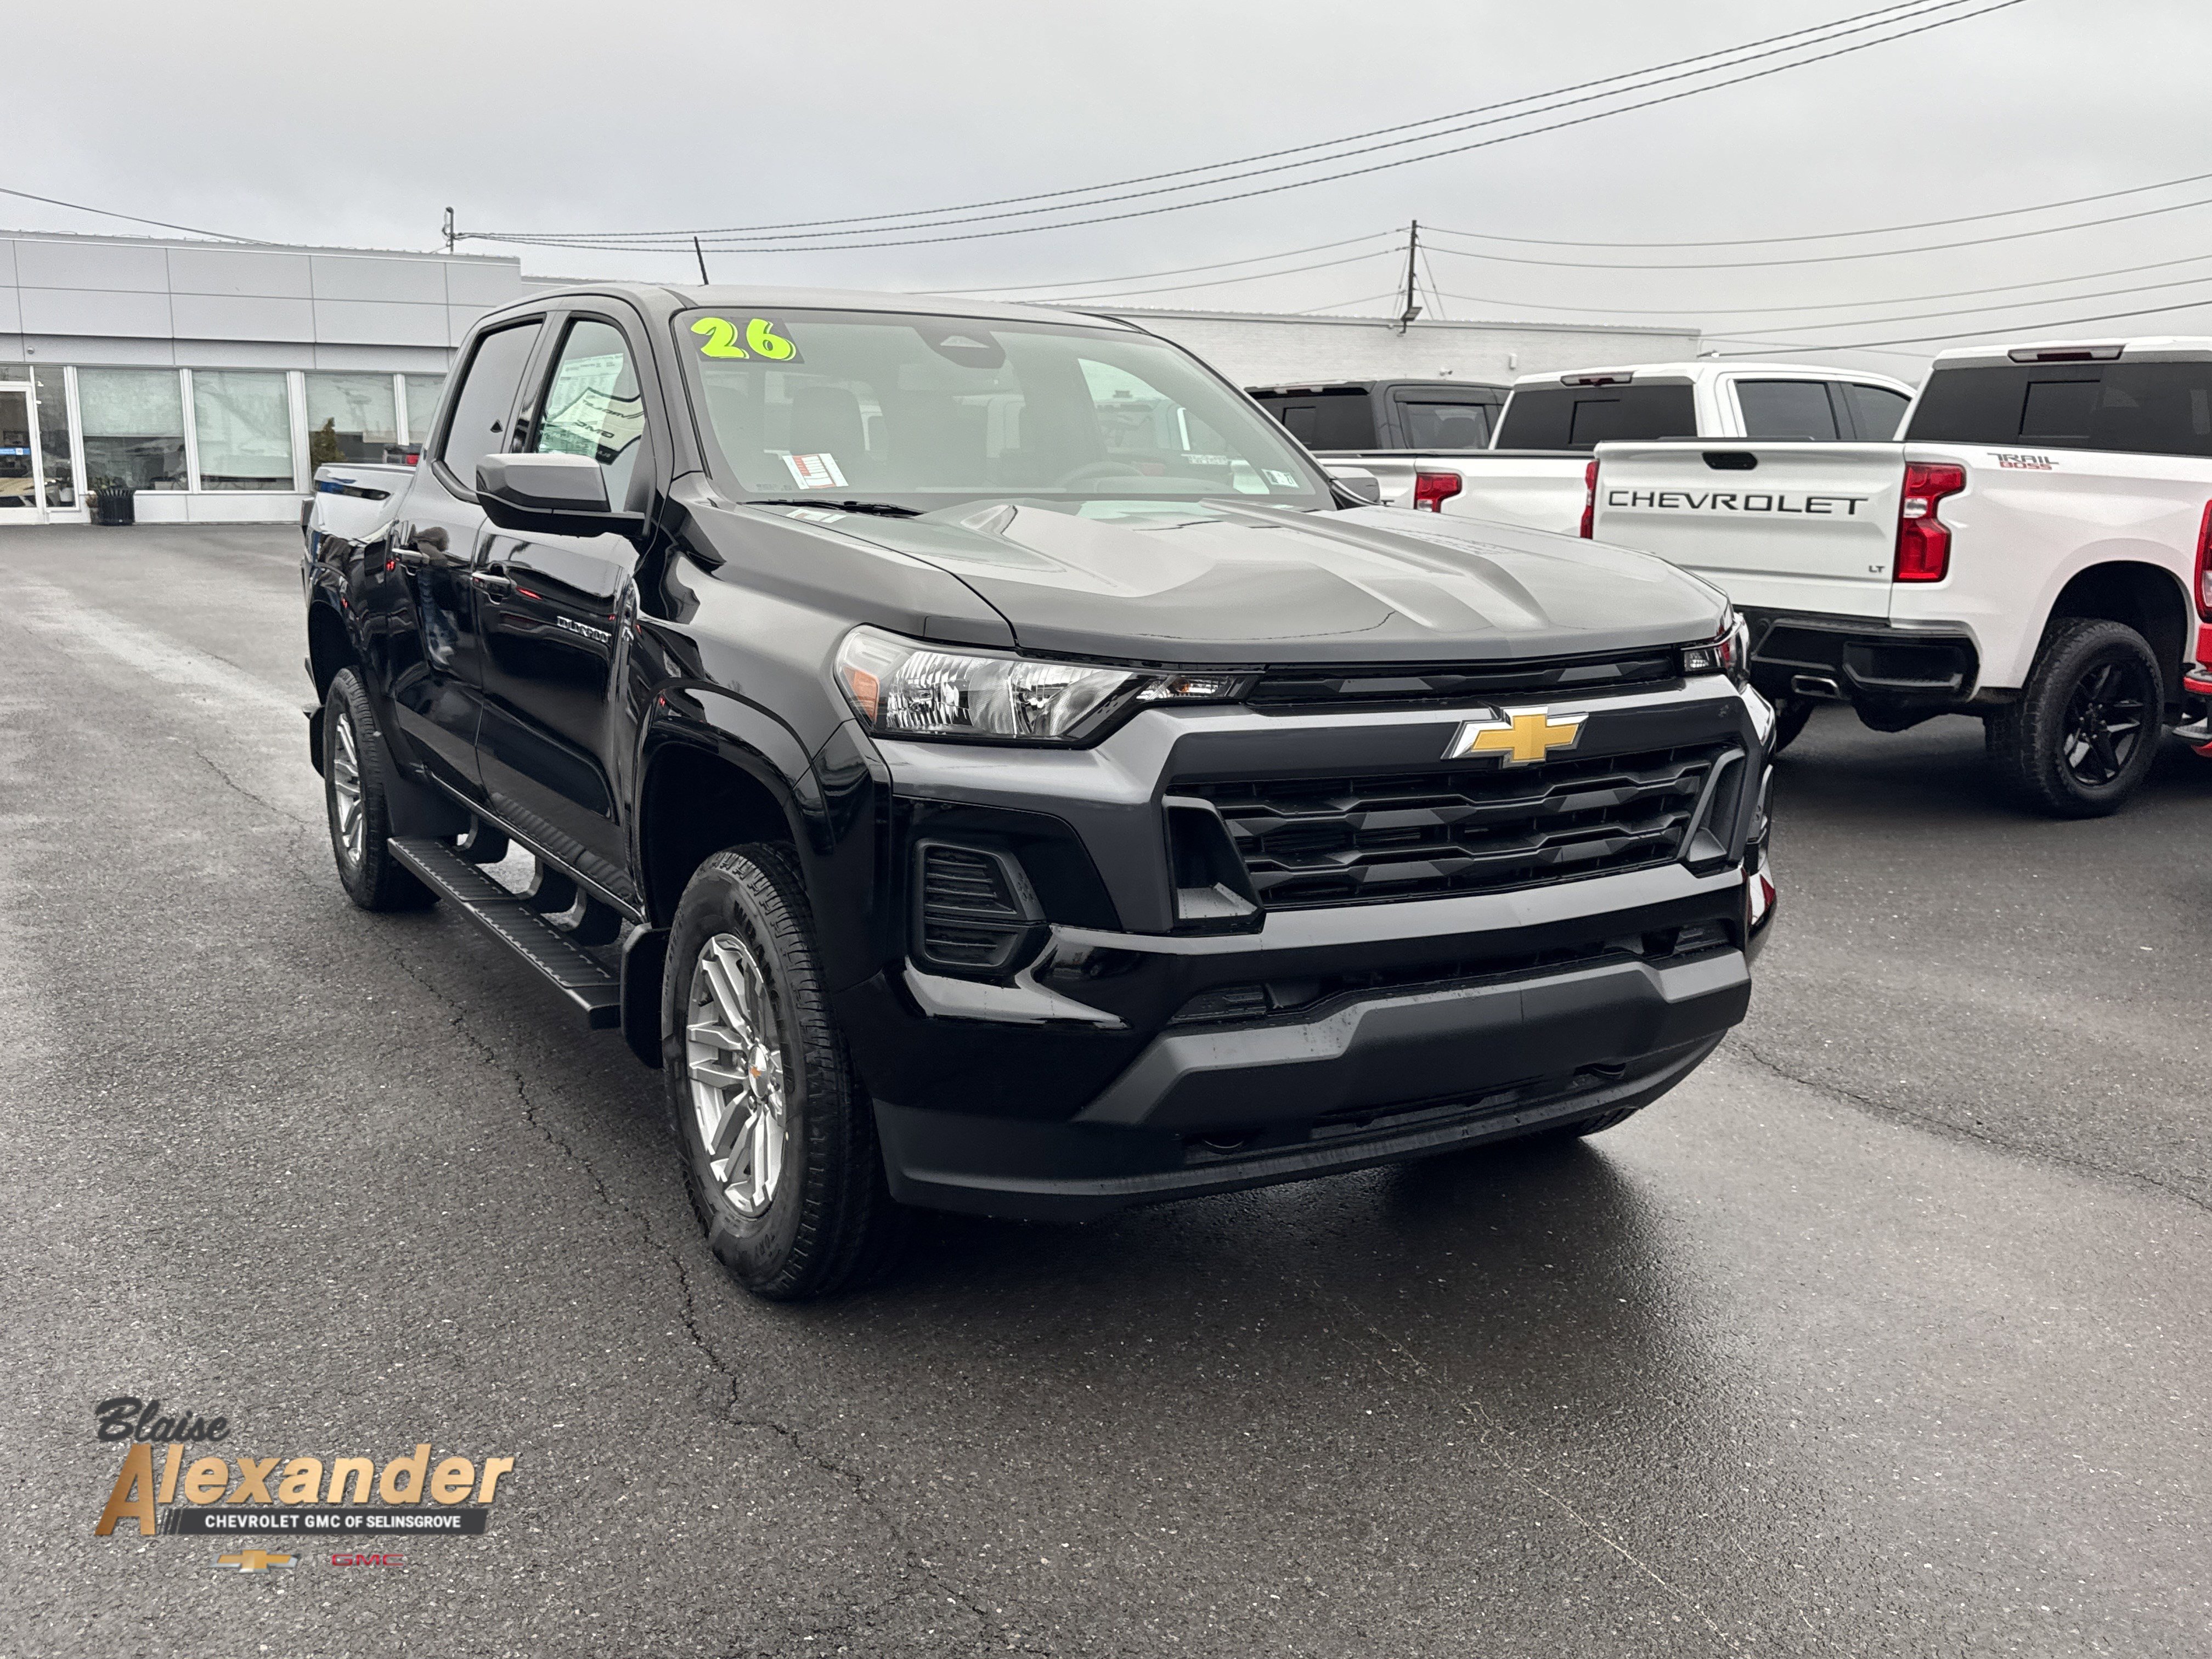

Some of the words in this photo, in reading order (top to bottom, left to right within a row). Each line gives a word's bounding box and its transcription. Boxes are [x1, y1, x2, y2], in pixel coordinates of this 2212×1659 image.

[690, 317, 797, 361] 26
[1987, 453, 2059, 465] TRAIL
[2000, 461, 2052, 470] BOSS
[1608, 490, 1869, 516] CHEVROLET
